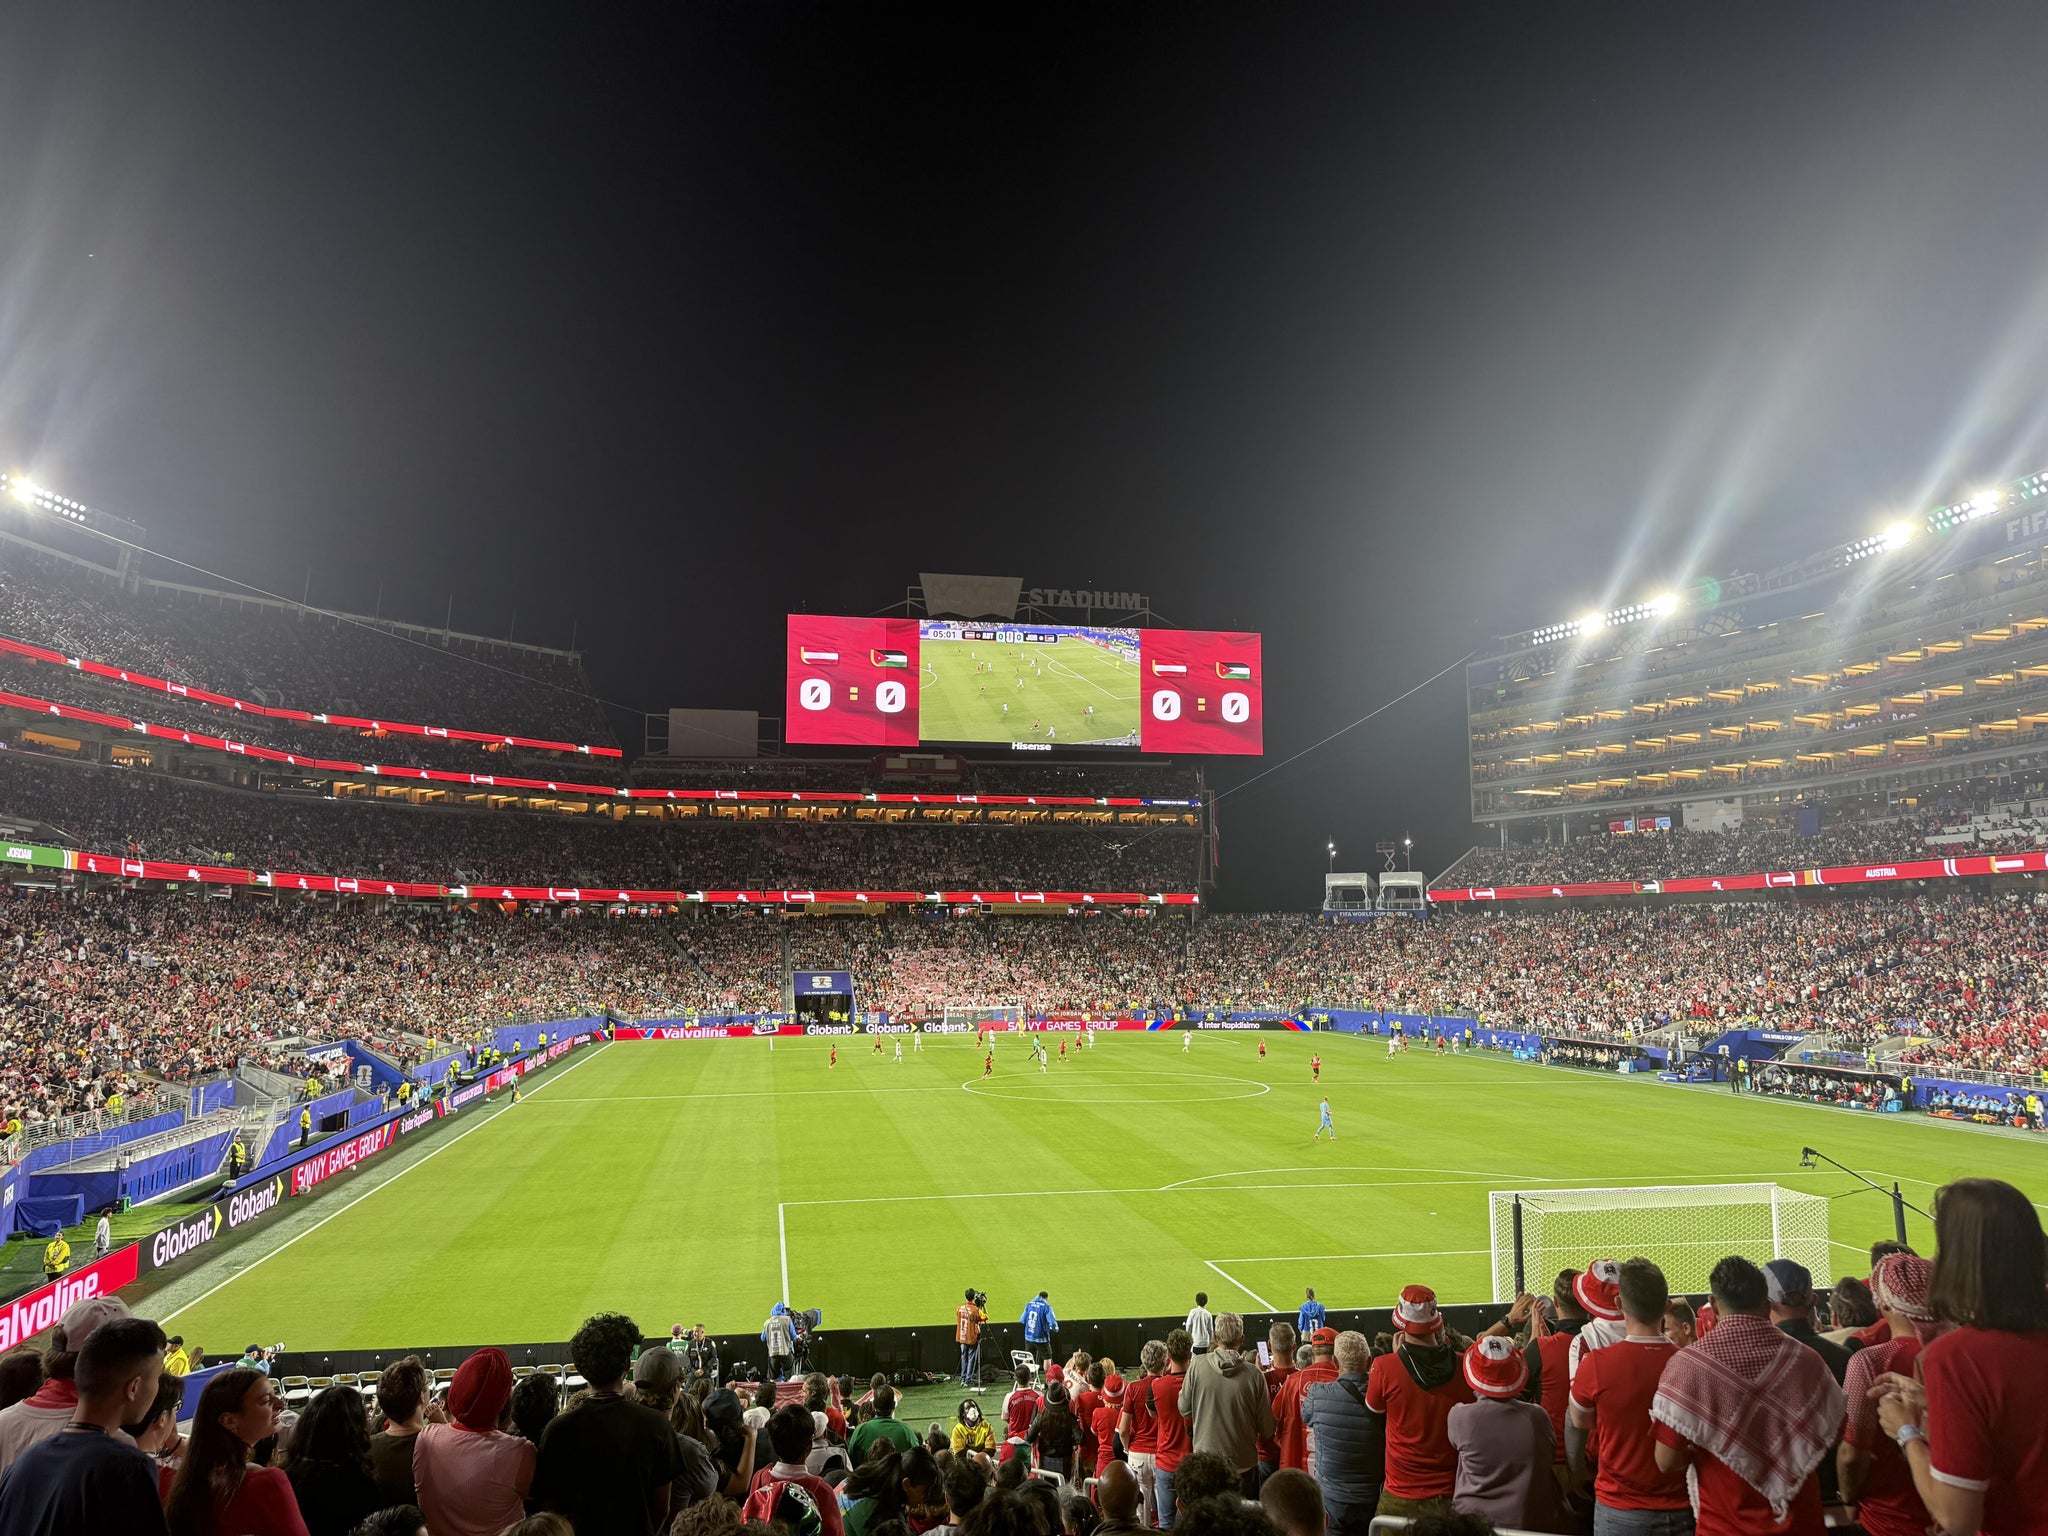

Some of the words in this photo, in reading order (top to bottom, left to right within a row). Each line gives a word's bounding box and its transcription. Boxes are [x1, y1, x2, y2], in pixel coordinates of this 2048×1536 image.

[1028, 588, 1142, 610] STADIUM
[933, 630, 956, 638] 05:01
[800, 678, 831, 711] 0
[875, 680, 906, 713] 0
[1152, 689, 1181, 721] 0
[1221, 692, 1250, 723] 0
[1011, 741, 1052, 751] Hisense
[6, 847, 32, 860] JORDAN
[1865, 867, 1897, 878] AUSTRIA
[807, 1024, 852, 1036] Globant
[866, 1023, 910, 1035] Globant
[924, 1022, 967, 1034] Globant
[1046, 1021, 1081, 1031] GAMES
[1085, 1021, 1119, 1031] GROUP
[1204, 1021, 1220, 1029] Inter
[661, 1028, 728, 1039] Valvoline
[297, 1156, 326, 1188] SAVVY
[329, 1142, 356, 1173] GAMES
[358, 1130, 382, 1158] GROUP
[228, 1181, 276, 1228] Globant
[152, 1211, 212, 1267] Globant
